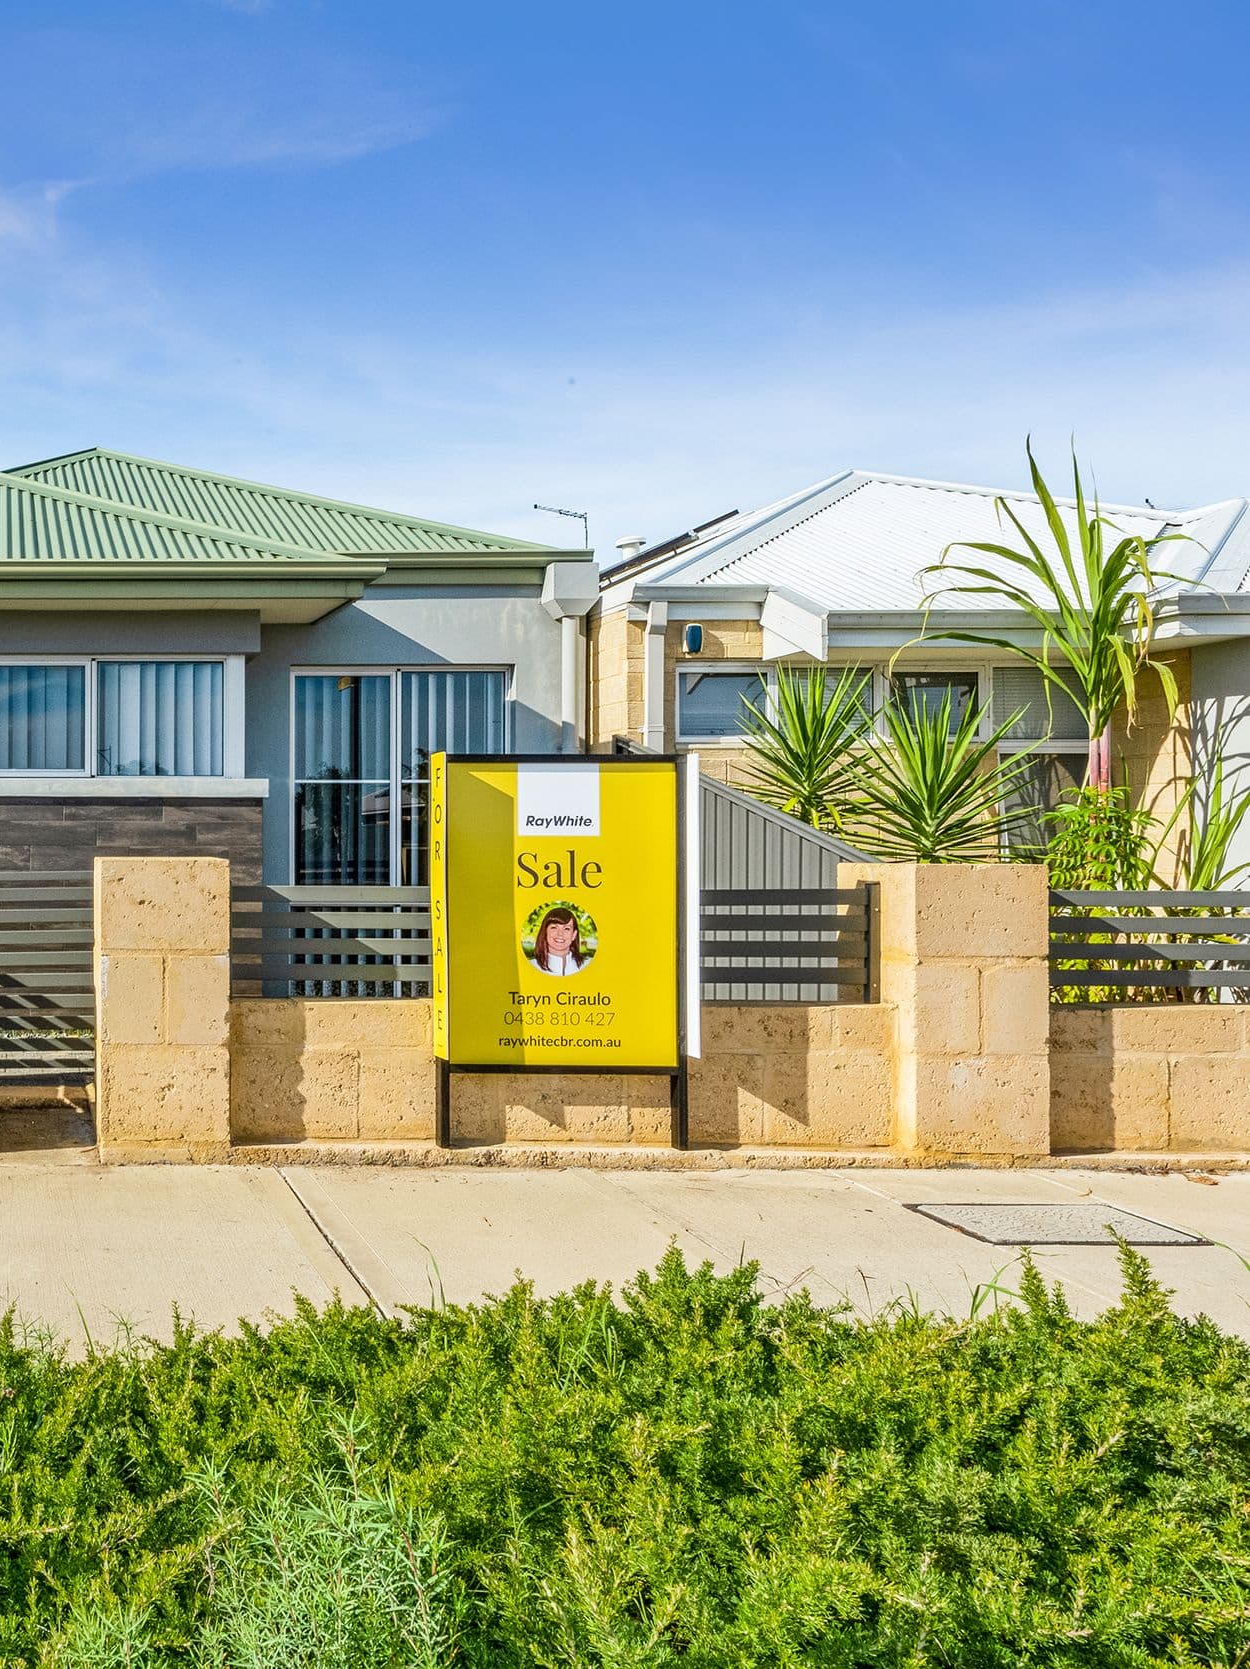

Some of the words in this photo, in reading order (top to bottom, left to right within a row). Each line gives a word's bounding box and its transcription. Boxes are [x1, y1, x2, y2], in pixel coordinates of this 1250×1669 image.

[516, 850, 603, 889] Sale
[435, 900, 443, 1030] SALE
[508, 991, 551, 1008] Taryn
[556, 992, 611, 1006] Ciraulo
[503, 1011, 545, 1026] 0438
[550, 1012, 581, 1026] 810
[584, 1012, 616, 1026] 427
[498, 1035, 621, 1049] raywhitecbr.com.au
